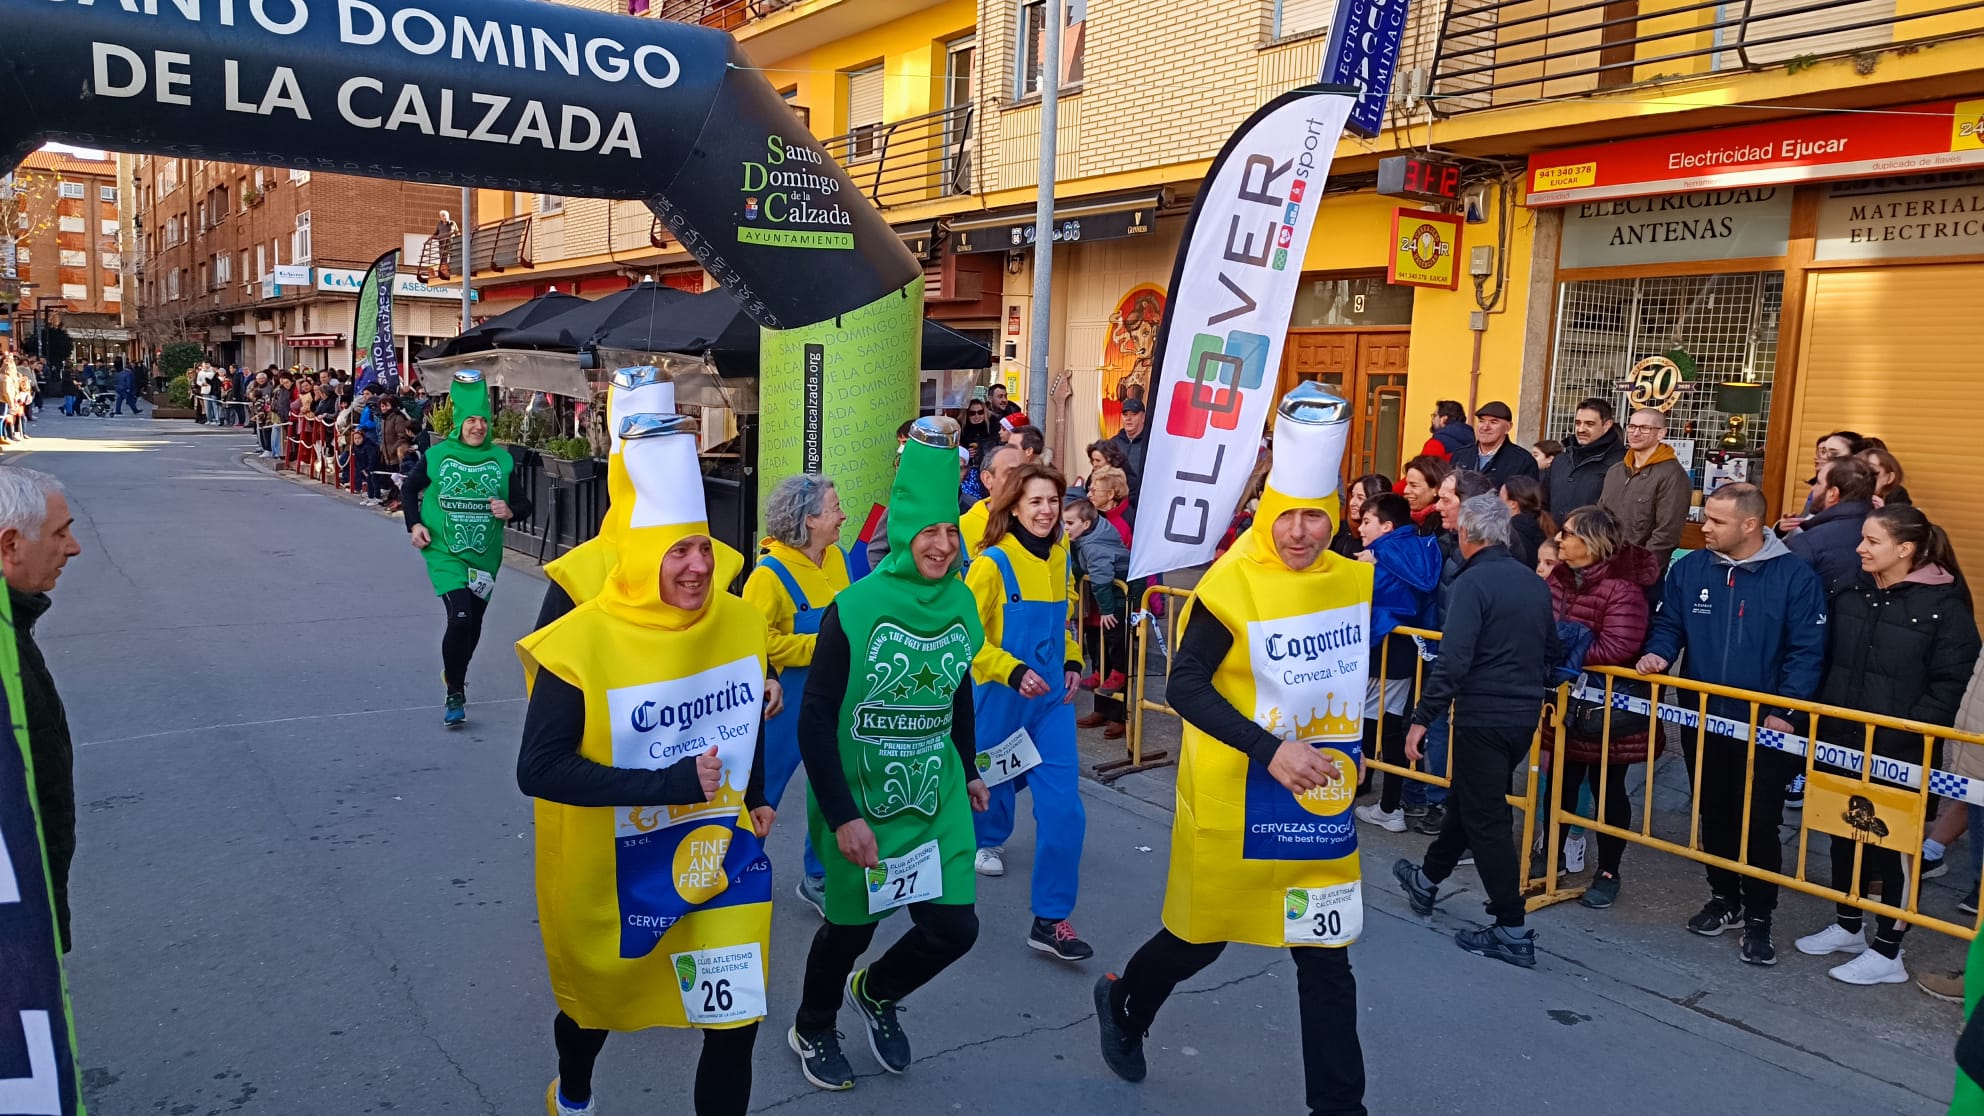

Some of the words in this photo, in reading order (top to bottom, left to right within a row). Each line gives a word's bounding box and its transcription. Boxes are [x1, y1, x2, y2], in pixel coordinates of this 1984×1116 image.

[337, 0, 681, 88] DOMINGO
[92, 41, 191, 106] DE
[224, 59, 312, 121] LA
[337, 76, 642, 159] CALZADA
[767, 134, 823, 165] Santo
[1296, 117, 1324, 179] sport
[1668, 143, 1773, 170] Electricidad
[1781, 137, 1849, 160] Ejucar
[1539, 168, 1555, 179] 941
[1557, 167, 1574, 178] 340
[1575, 165, 1592, 176] 378
[1872, 158, 1916, 171] duplicado
[1919, 157, 1932, 167] de
[740, 161, 839, 195] Domingo
[1550, 177, 1578, 187] EJUCAR
[790, 190, 802, 201] de
[803, 191, 811, 201] la
[764, 192, 852, 226] Calzada
[745, 231, 848, 246] AYUNTAMIENTO
[1609, 216, 1733, 246] ANTENAS
[1400, 237, 1417, 251] 24
[1433, 242, 1449, 256] HR
[1355, 296, 1363, 311] 9
[825, 317, 897, 346] DOMINGO
[385, 344, 394, 359] LA
[857, 335, 899, 358] SANTO
[374, 348, 387, 386] SANTO
[388, 361, 398, 376] DE
[842, 367, 860, 380] LA
[838, 370, 905, 401] DOMINGO
[1631, 365, 1678, 403] 50
[832, 425, 852, 439] DE
[475, 581, 487, 594] 28
[889, 631, 905, 642] THE
[1265, 621, 1362, 661] Cogorcita
[1283, 668, 1333, 686] Cerveza
[1338, 659, 1358, 676] Beer
[631, 680, 755, 733] Cogorcita
[1640, 701, 1681, 723] LOCL
[1685, 711, 1735, 738] POLIIA
[649, 736, 707, 760] Cerveza
[717, 722, 751, 742] Beer
[1799, 740, 1846, 765] LOCL
[996, 752, 1022, 775] 74
[1251, 823, 1316, 834] CERVEZAS
[1277, 834, 1293, 843] The
[1295, 834, 1314, 843] best
[1316, 834, 1329, 843] for
[623, 838, 637, 848] 33
[690, 838, 729, 857] FINE
[892, 870, 918, 900] 27
[1312, 893, 1327, 901] CLUB
[1312, 910, 1341, 936] 30
[701, 962, 749, 975] CALCEATENSE
[713, 951, 753, 964] ATLETISMO
[701, 978, 733, 1012] 26
